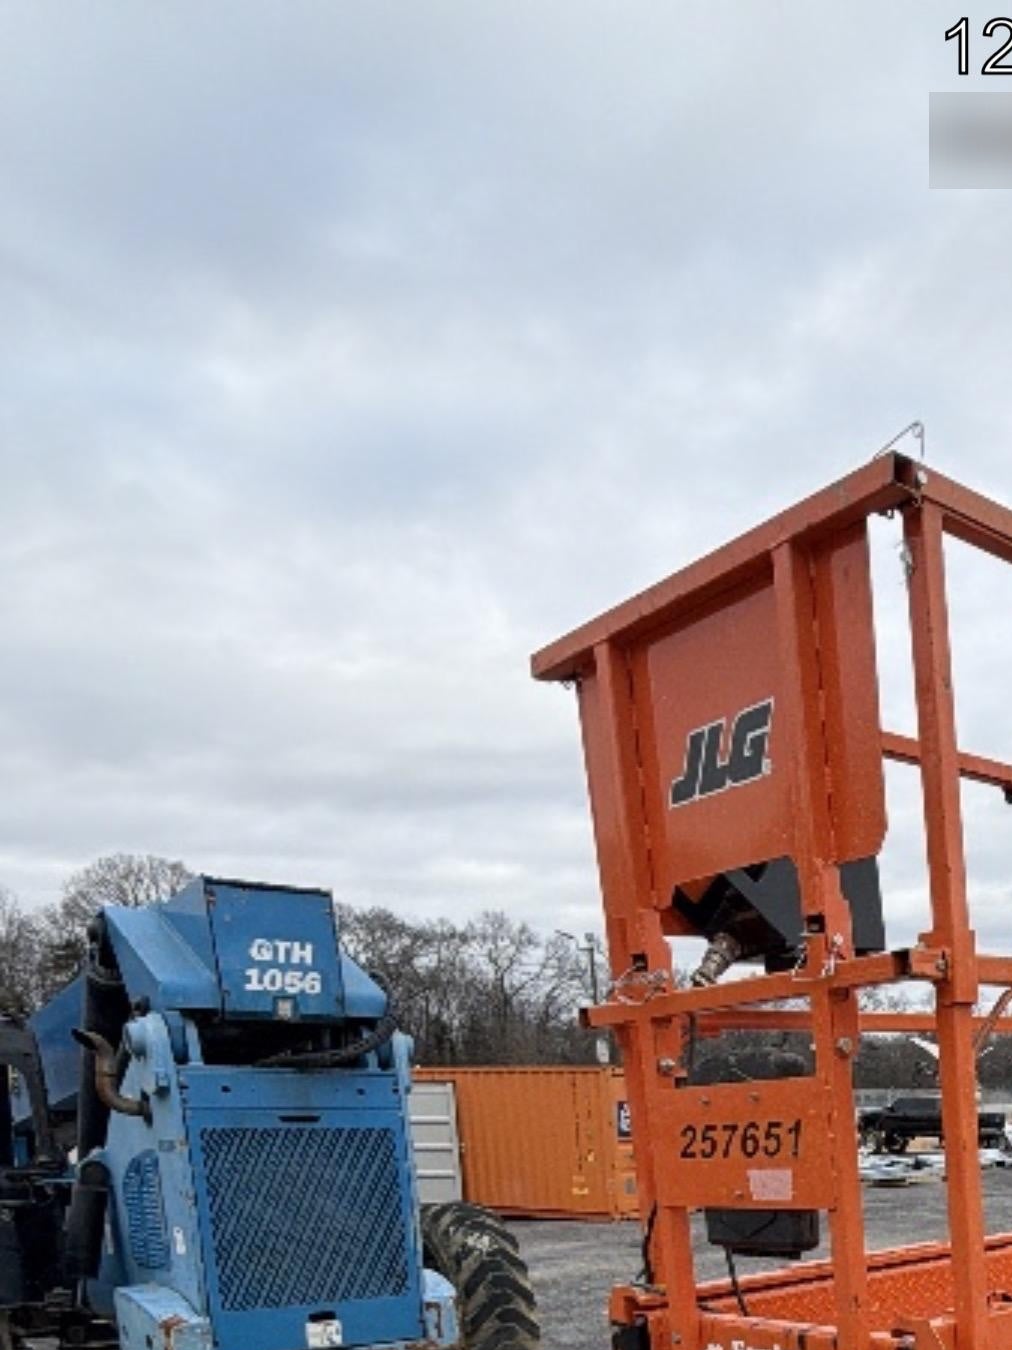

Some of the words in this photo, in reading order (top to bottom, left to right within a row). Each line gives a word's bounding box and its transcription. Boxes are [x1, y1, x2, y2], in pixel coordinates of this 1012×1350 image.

[668, 696, 774, 811] JLG
[249, 938, 313, 966] GTH
[244, 968, 322, 994] 1056
[680, 1119, 802, 1159] 257651
